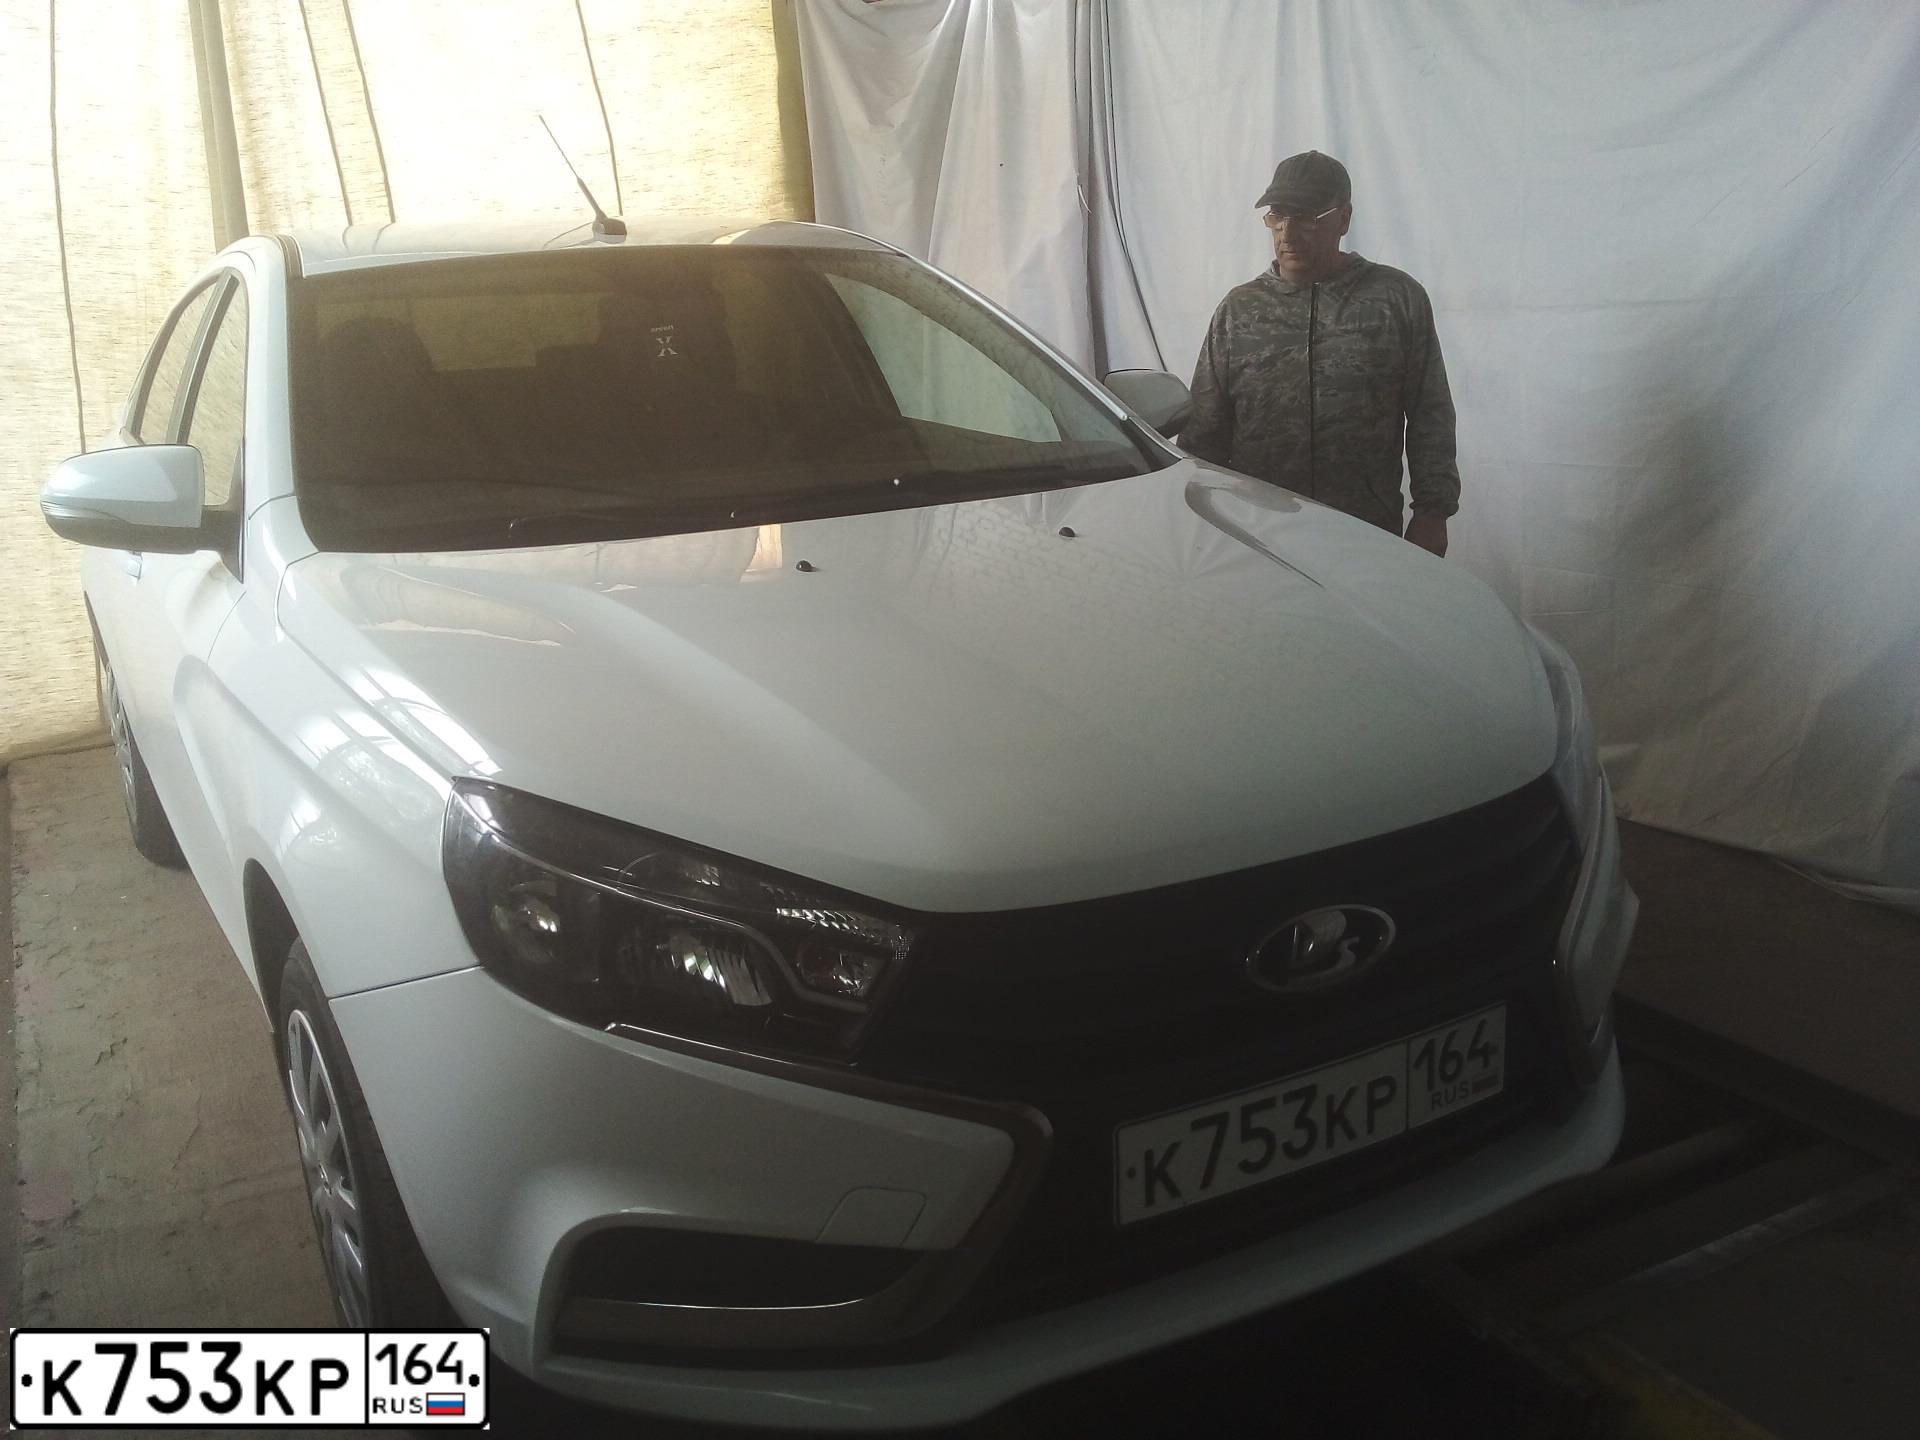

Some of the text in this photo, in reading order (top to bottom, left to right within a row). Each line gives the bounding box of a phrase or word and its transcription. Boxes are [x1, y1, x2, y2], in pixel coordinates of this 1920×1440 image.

[1143, 1018, 1498, 1207] K753KP 164
[1429, 1080, 1471, 1111] RUS
